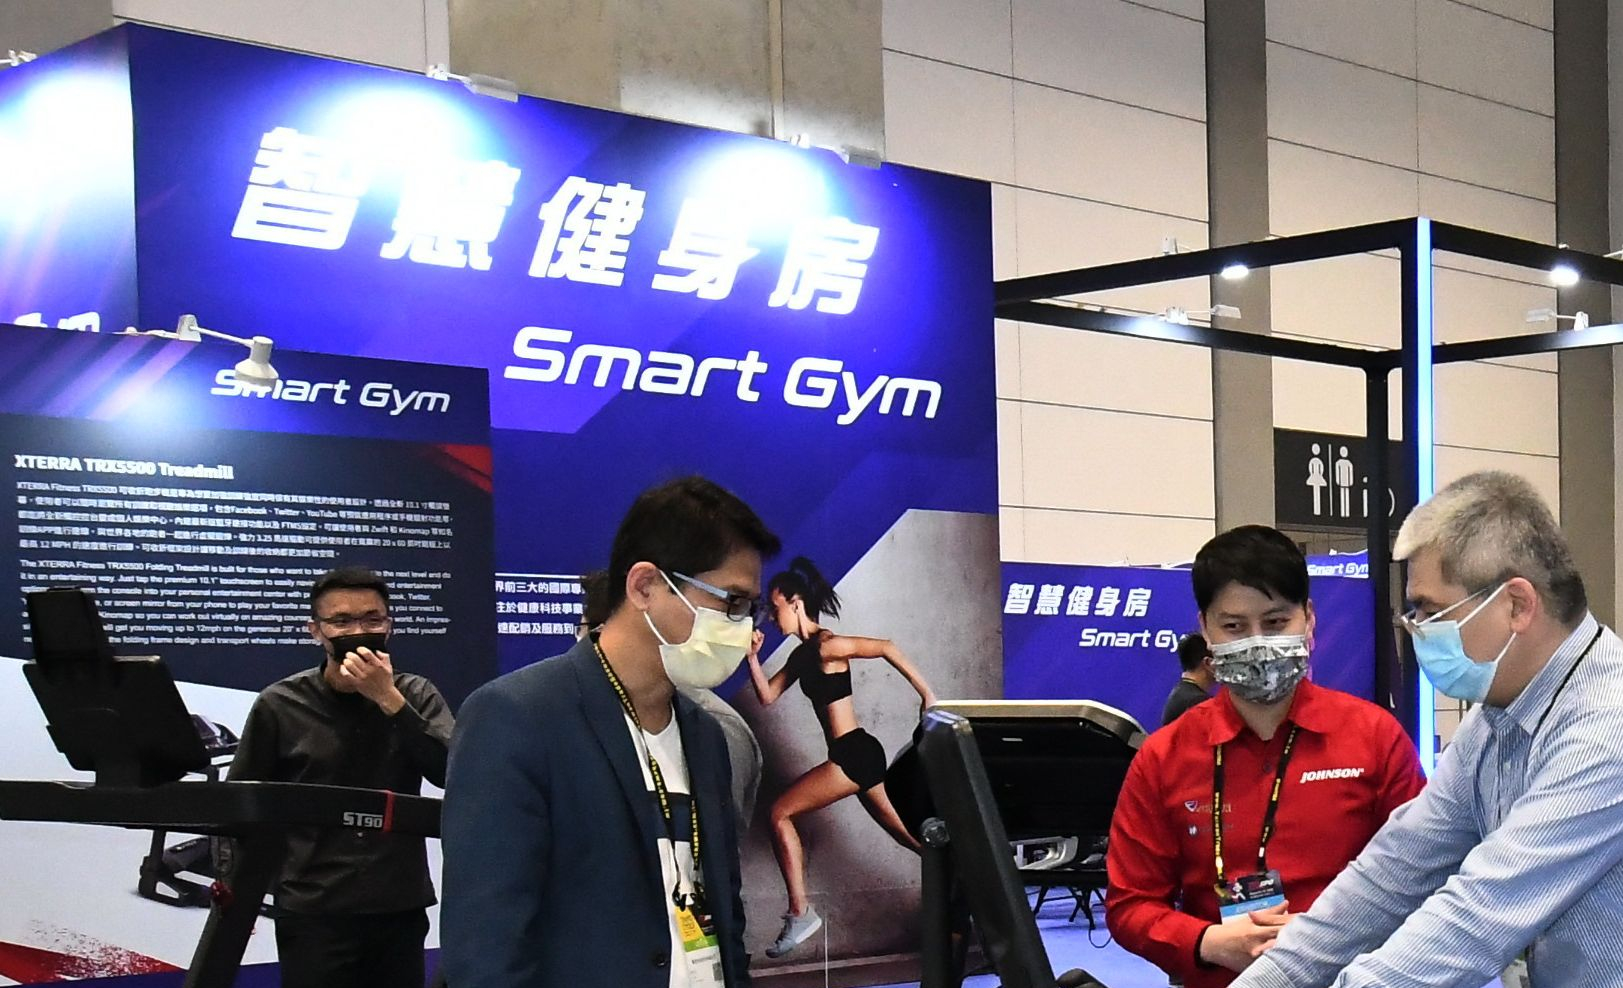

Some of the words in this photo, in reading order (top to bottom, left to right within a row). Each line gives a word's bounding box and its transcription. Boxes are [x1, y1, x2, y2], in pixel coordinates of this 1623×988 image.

[232, 127, 879, 315] 智慧健身房
[504, 326, 767, 402] Smart
[783, 357, 941, 425] Gym
[359, 382, 451, 416] Gym
[15, 454, 81, 471] XTERRA
[83, 458, 156, 476] TRX5500
[160, 461, 234, 480] Treadmill
[1003, 583, 1152, 617] 智慧健身房
[1079, 628, 1151, 647] Smart
[1154, 629, 1189, 653] Gy
[1300, 768, 1362, 784] JOHNSON
[343, 811, 384, 828] ST90
